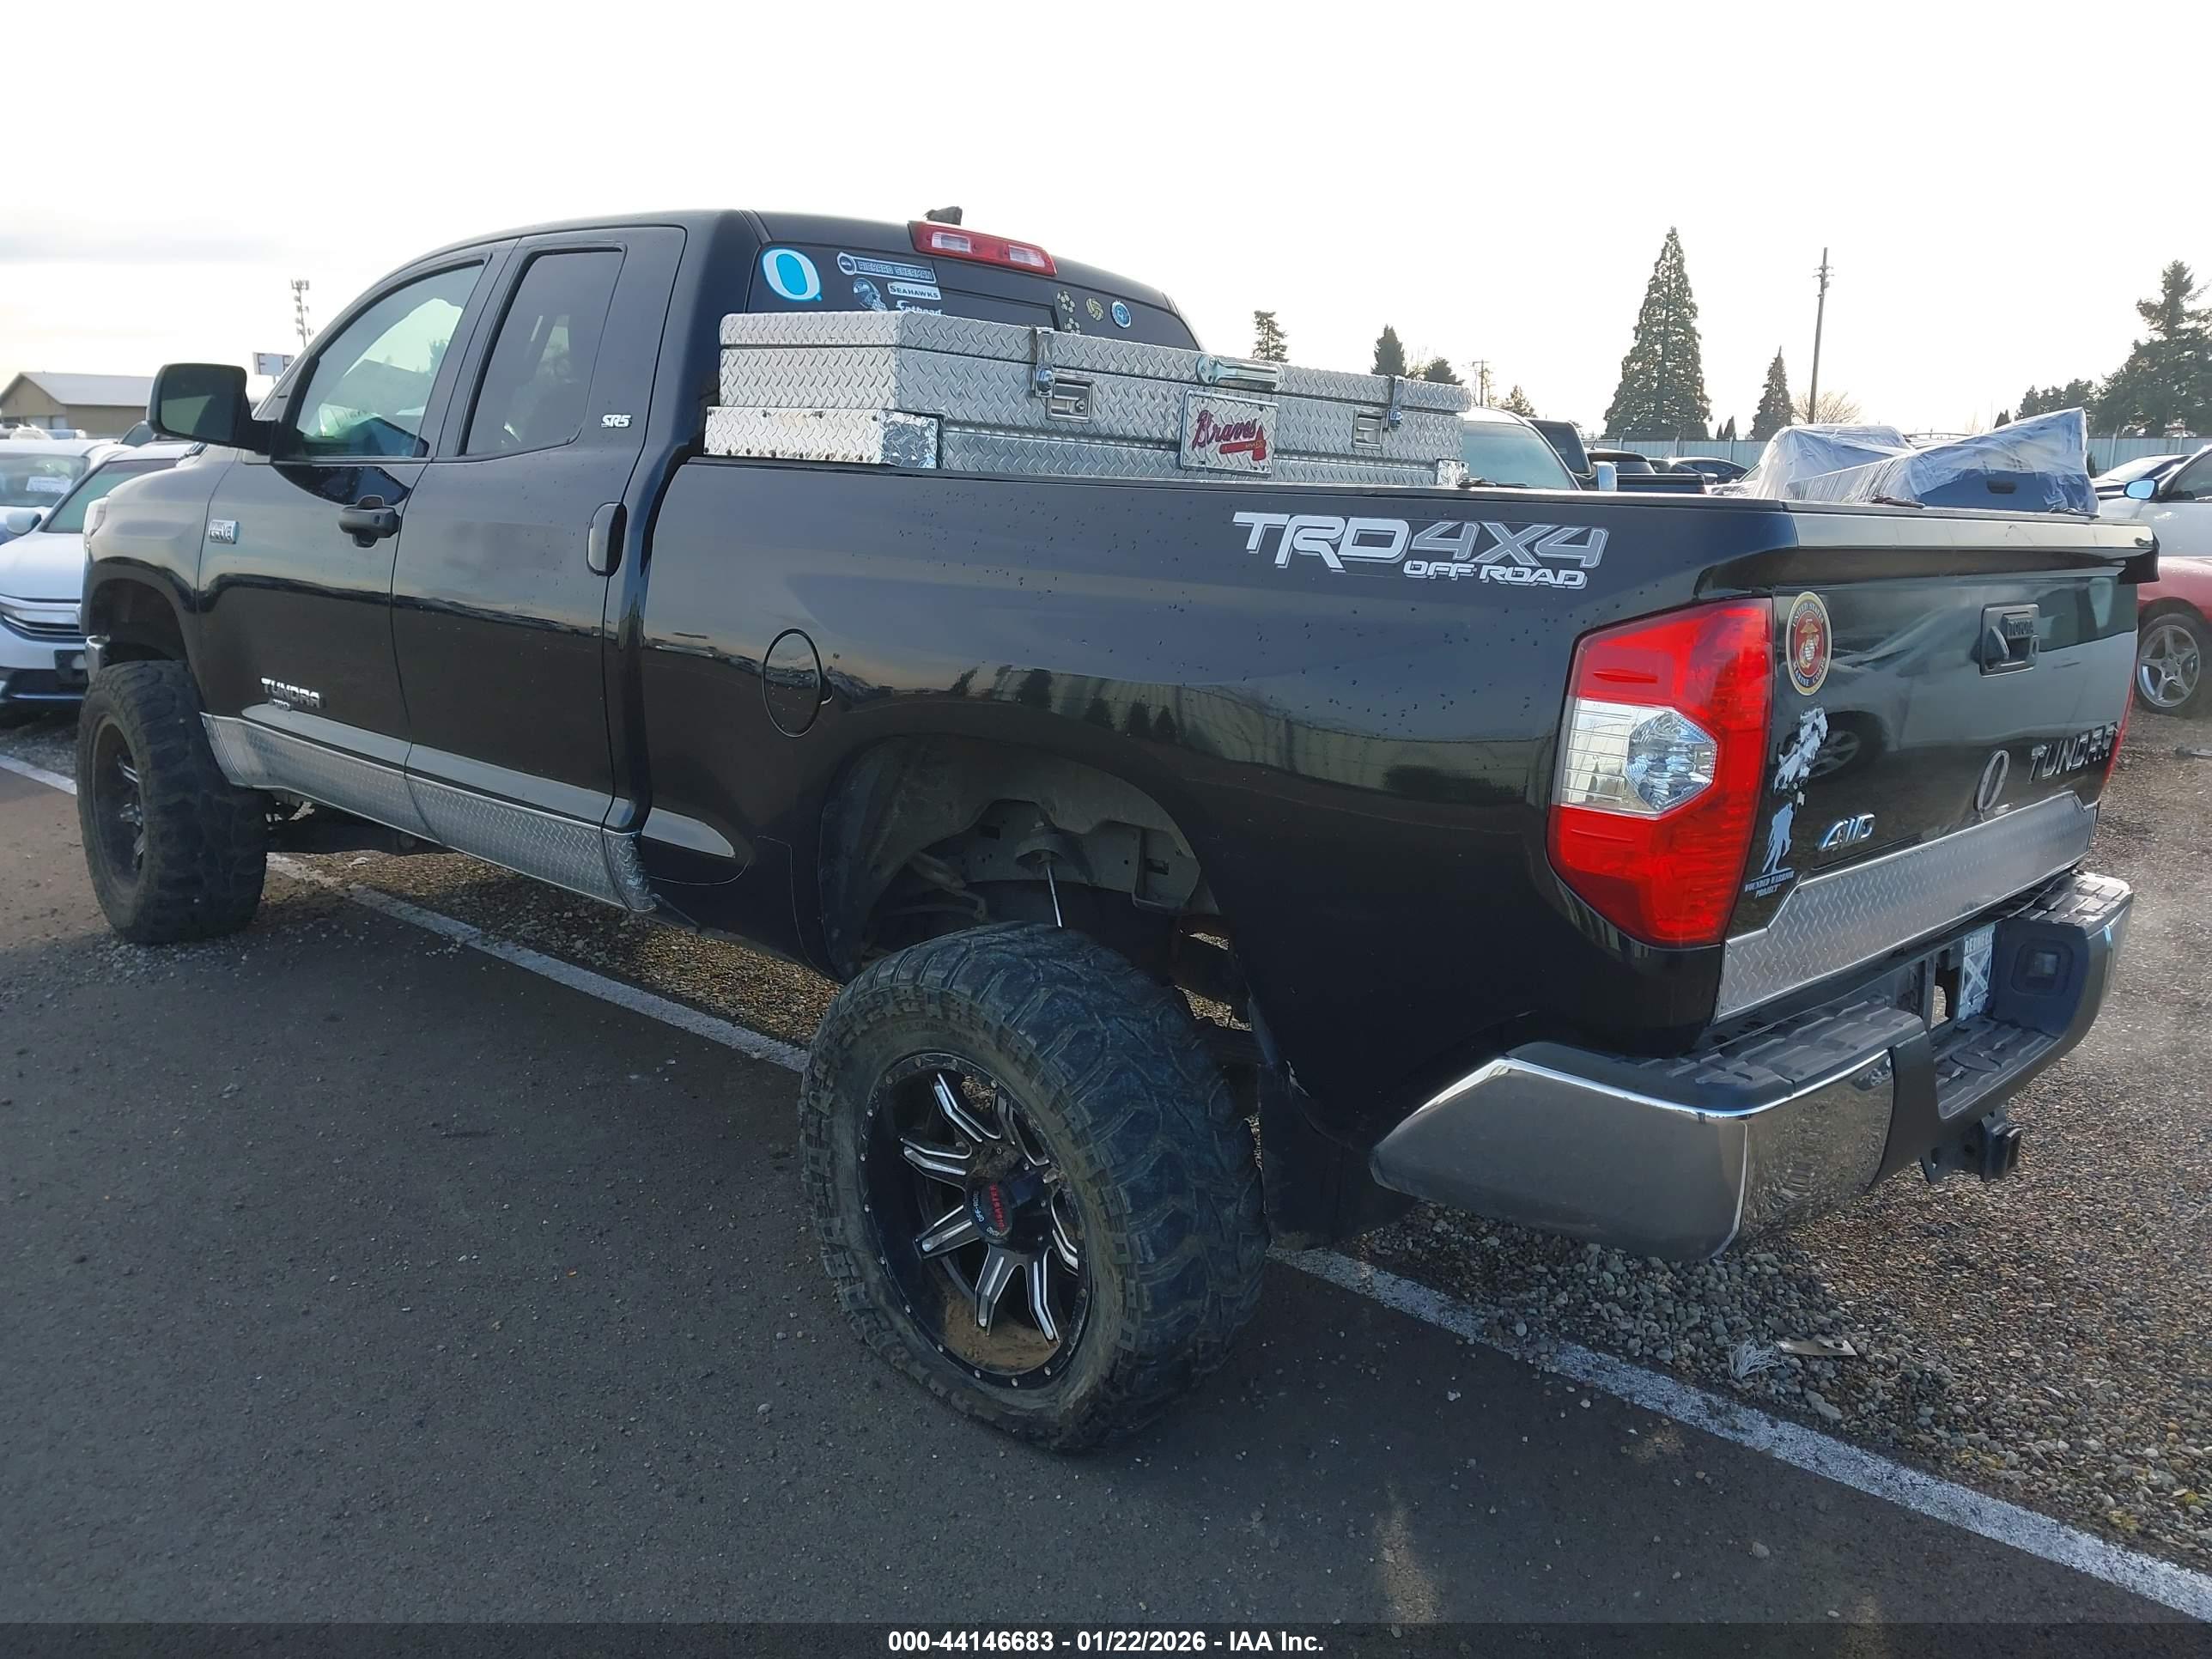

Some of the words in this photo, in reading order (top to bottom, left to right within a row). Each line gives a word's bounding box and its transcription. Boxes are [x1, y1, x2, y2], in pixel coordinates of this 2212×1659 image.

[890, 285, 939, 300] SEAHAWKS
[601, 414, 632, 428] SR5
[1192, 410, 1257, 451] Braves
[1233, 511, 1413, 573] TRD
[1403, 560, 1478, 581] OFF
[1479, 564, 1589, 590] ROAD
[261, 677, 320, 708] TUNDRA
